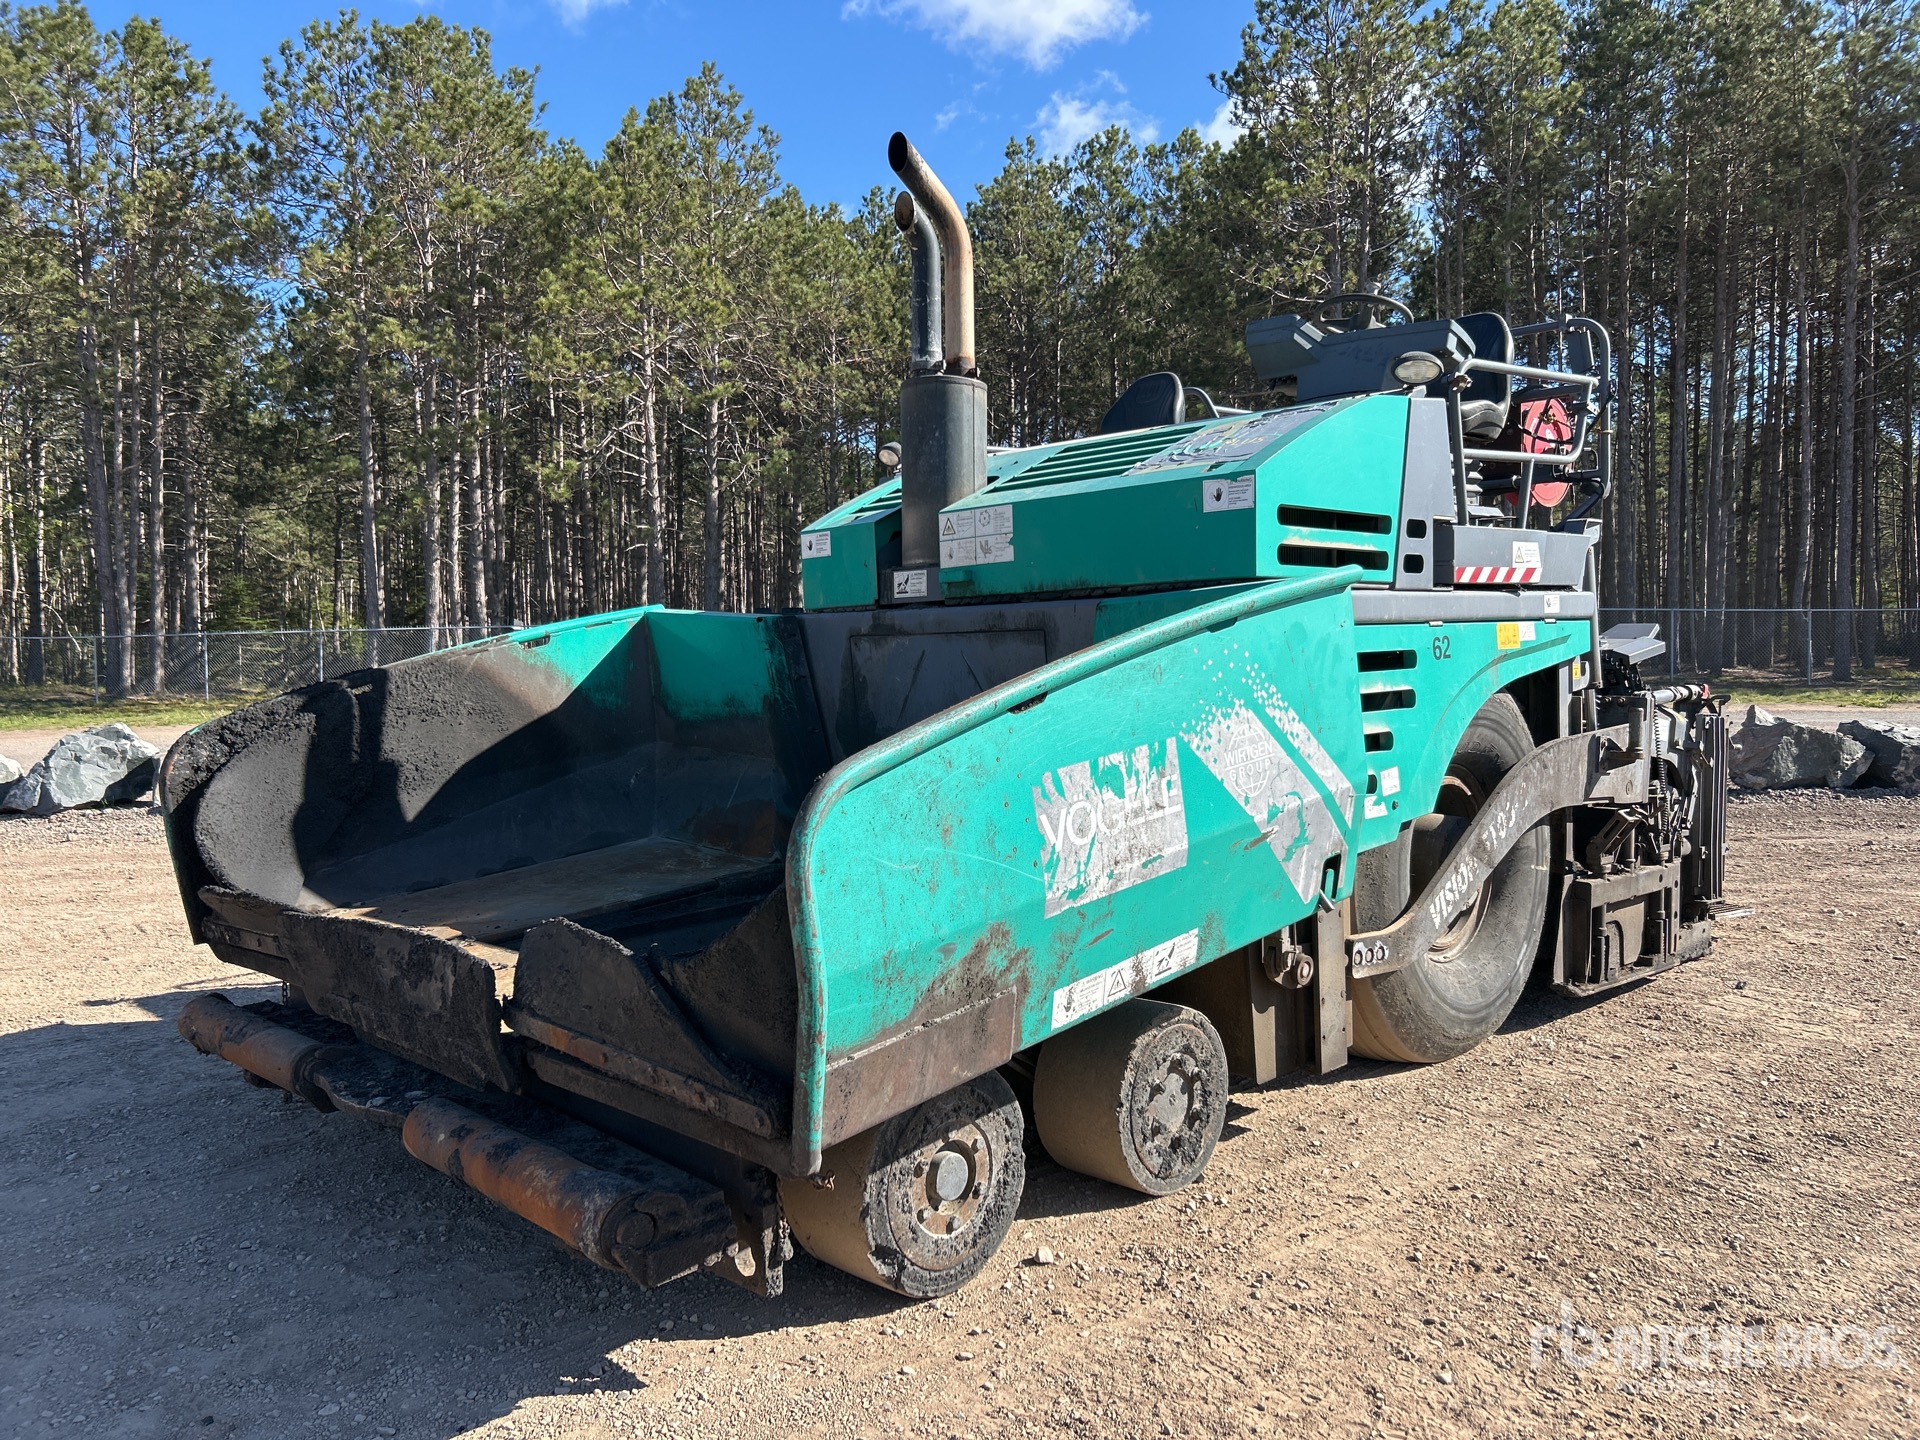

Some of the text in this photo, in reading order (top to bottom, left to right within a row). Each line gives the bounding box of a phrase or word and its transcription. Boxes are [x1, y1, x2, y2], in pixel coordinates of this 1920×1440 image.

[1432, 635, 1451, 660] 62
[1224, 739, 1274, 767] WIRTGEN
[1229, 759, 1272, 783] GROUP
[1429, 855, 1479, 930] VISION
